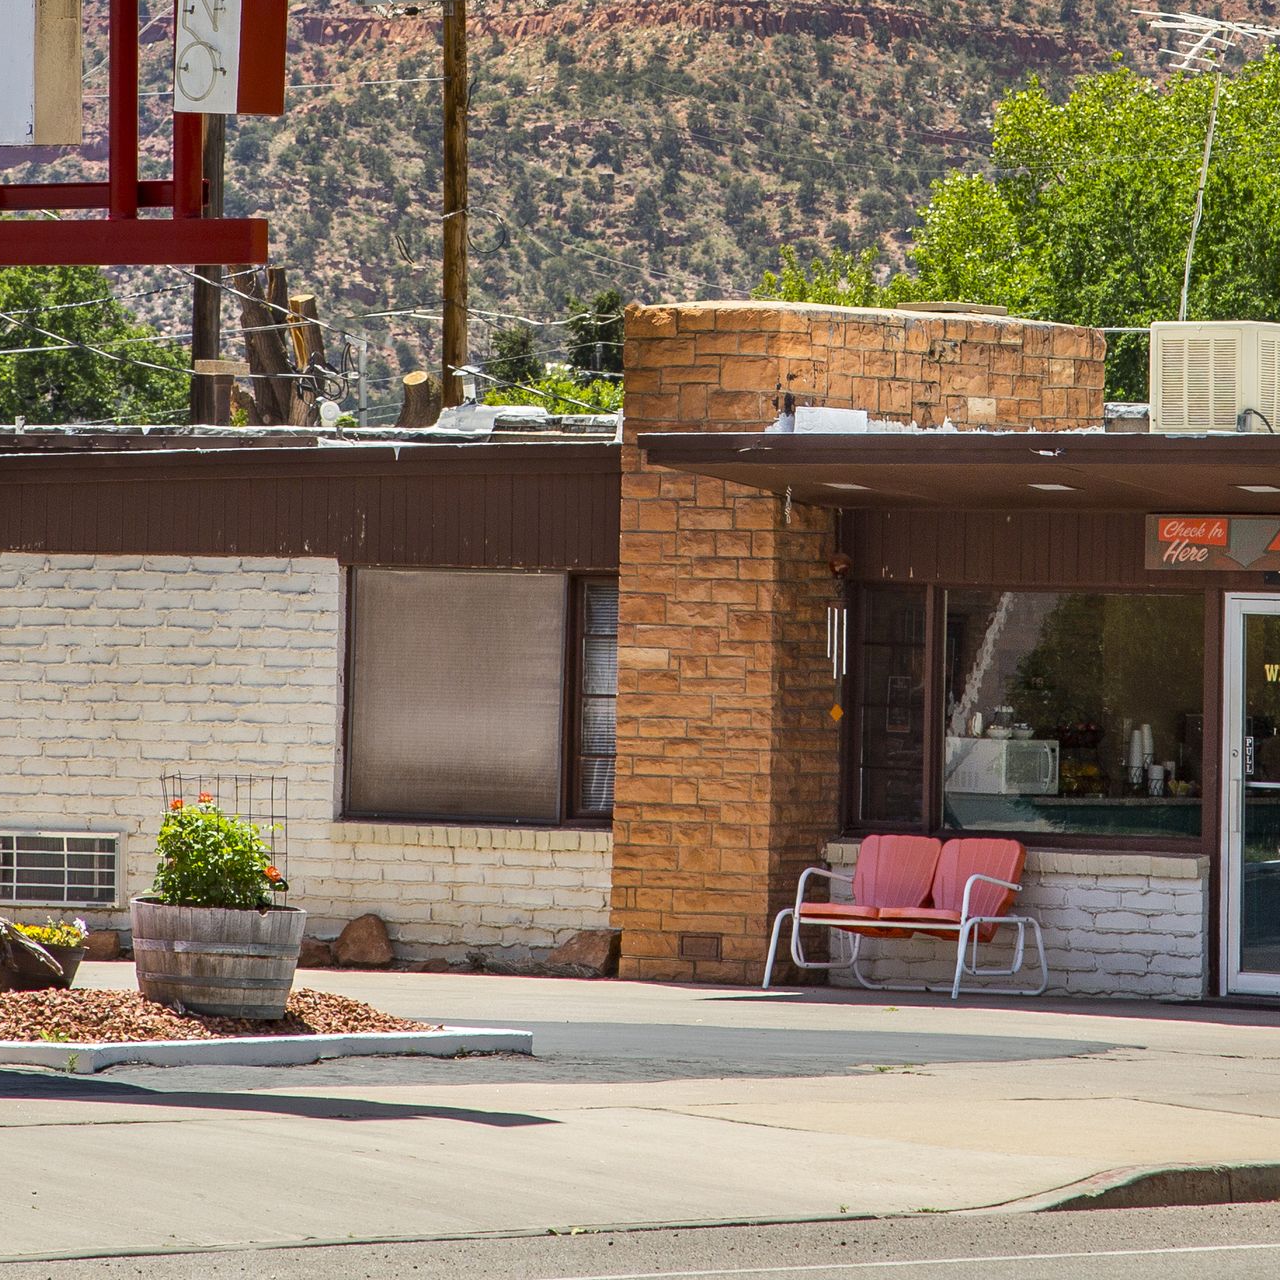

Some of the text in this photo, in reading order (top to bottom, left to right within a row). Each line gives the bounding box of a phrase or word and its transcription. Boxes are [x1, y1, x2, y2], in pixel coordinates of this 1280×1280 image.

[1163, 521, 1224, 538] Check In
[1163, 539, 1209, 564] Here
[1245, 737, 1253, 774] PULL
